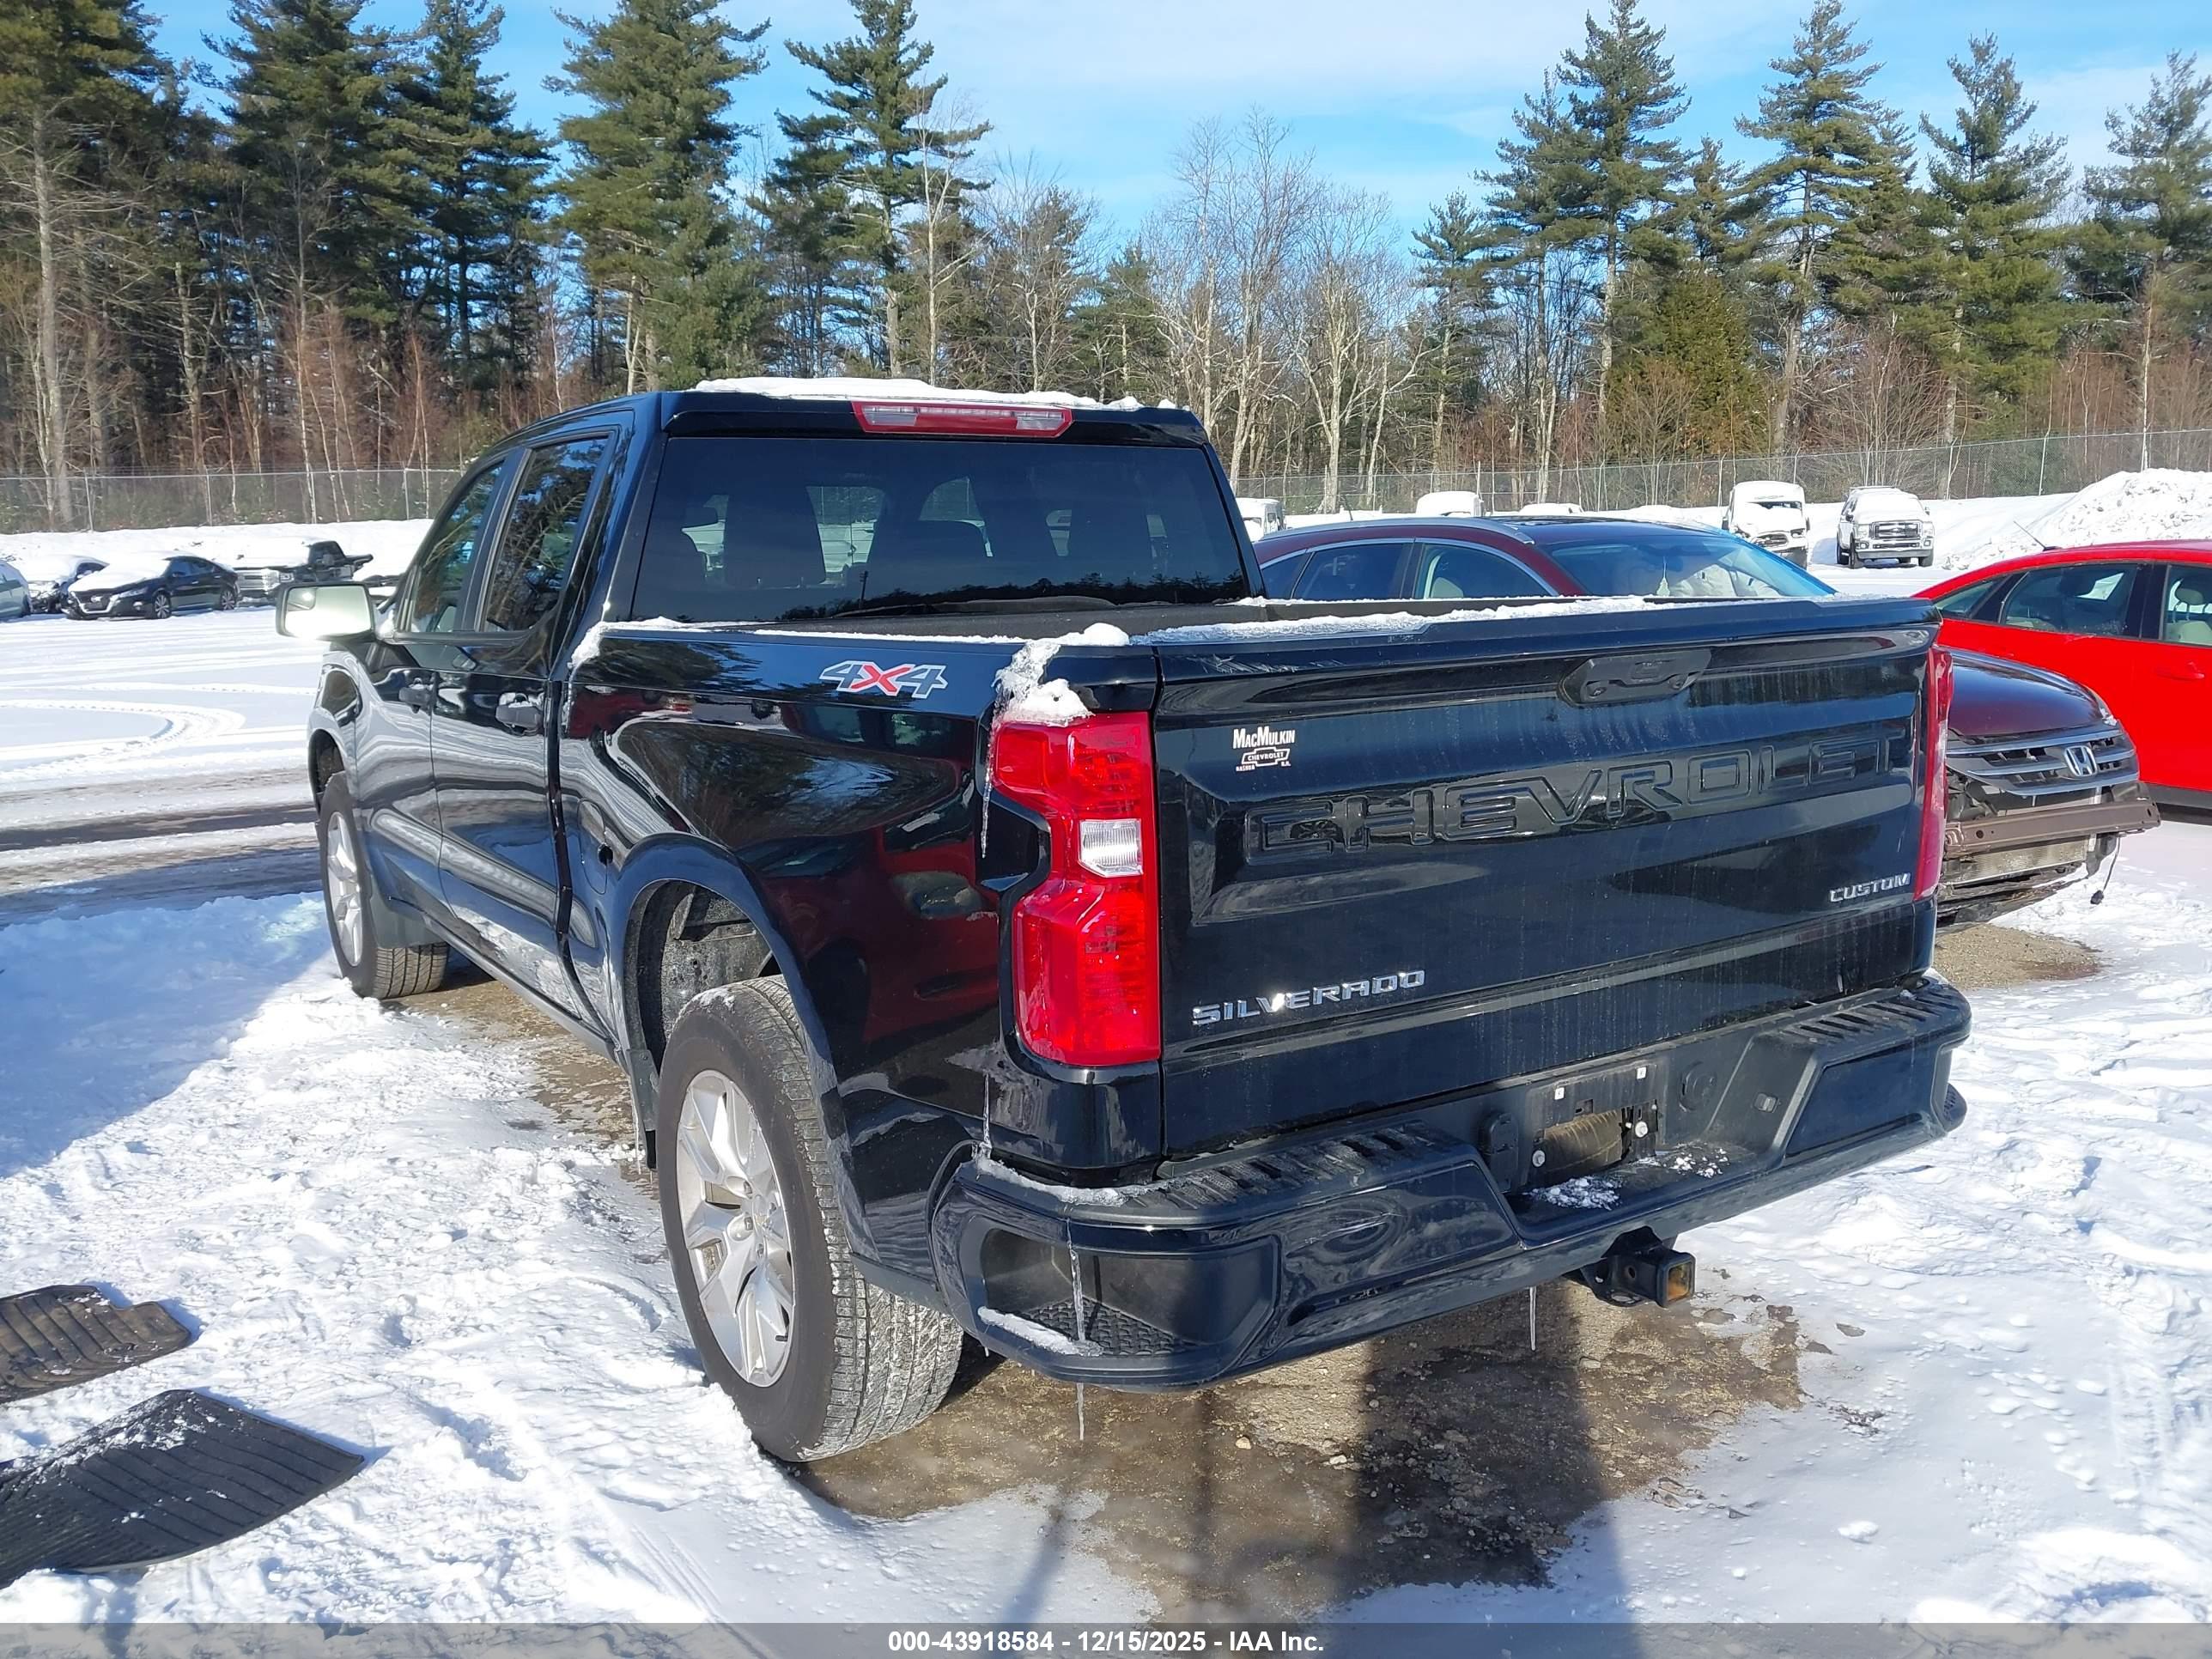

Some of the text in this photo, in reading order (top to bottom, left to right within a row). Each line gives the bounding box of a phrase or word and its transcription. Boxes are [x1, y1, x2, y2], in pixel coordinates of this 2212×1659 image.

[1248, 751, 1284, 761] CHEVROLET
[1244, 729, 1906, 865] CHEVROLET
[1829, 872, 1911, 902] CUSTOM
[1192, 969, 1425, 1025] SILVERADO
